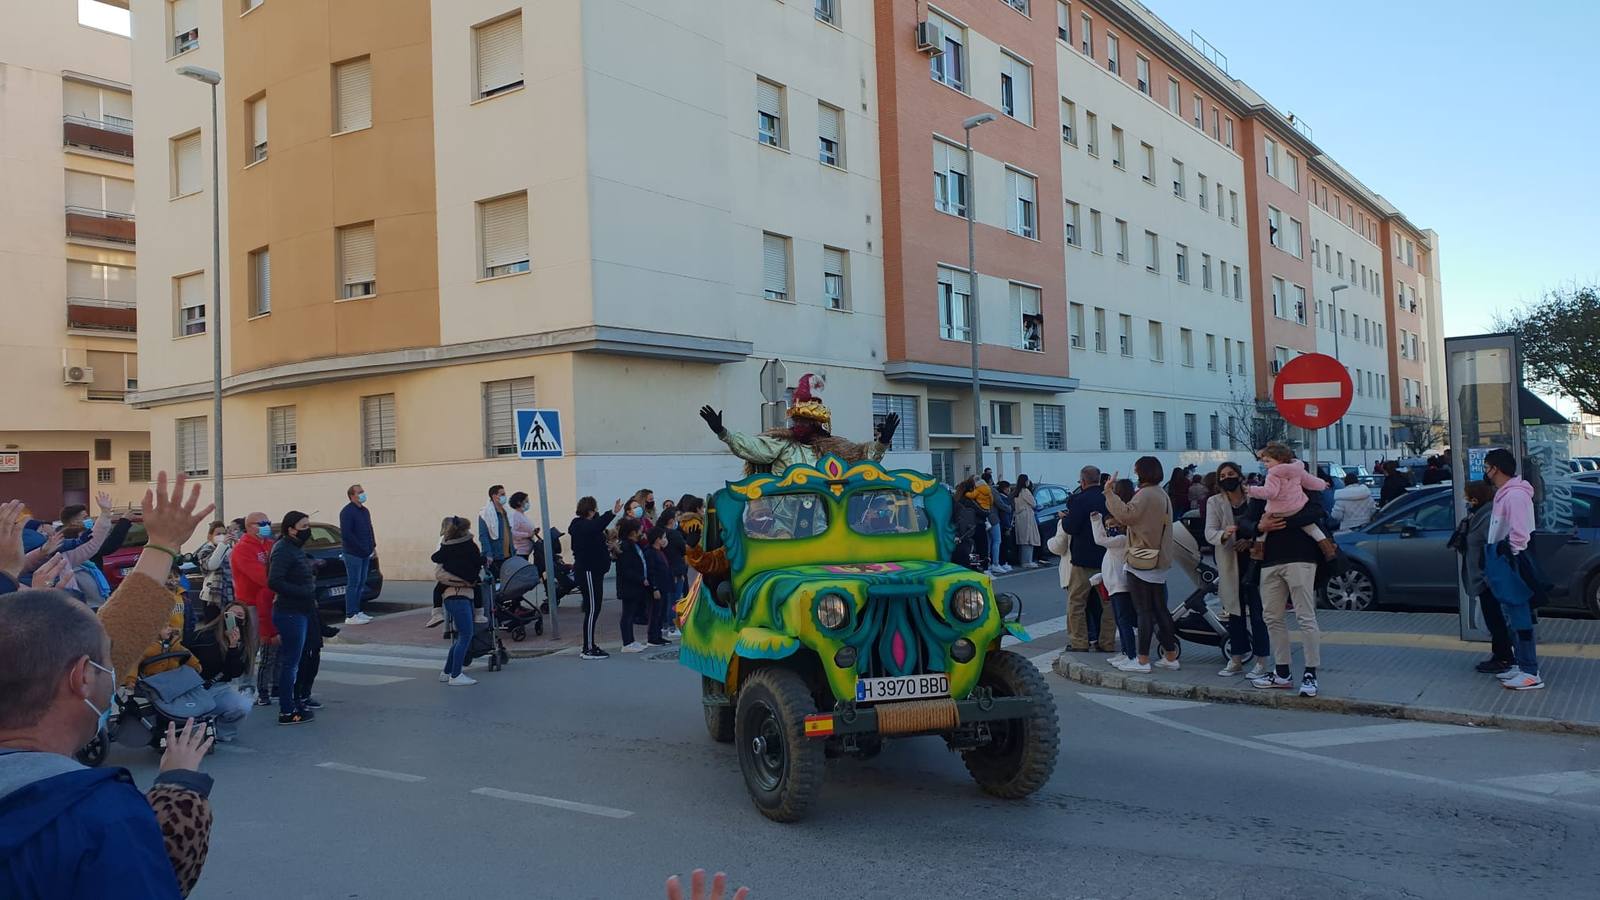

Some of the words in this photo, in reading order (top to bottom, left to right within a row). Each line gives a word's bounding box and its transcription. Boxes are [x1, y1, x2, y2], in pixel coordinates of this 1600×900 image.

[864, 681, 873, 698] H
[877, 679, 916, 697] 3970
[919, 677, 949, 694] BBD
